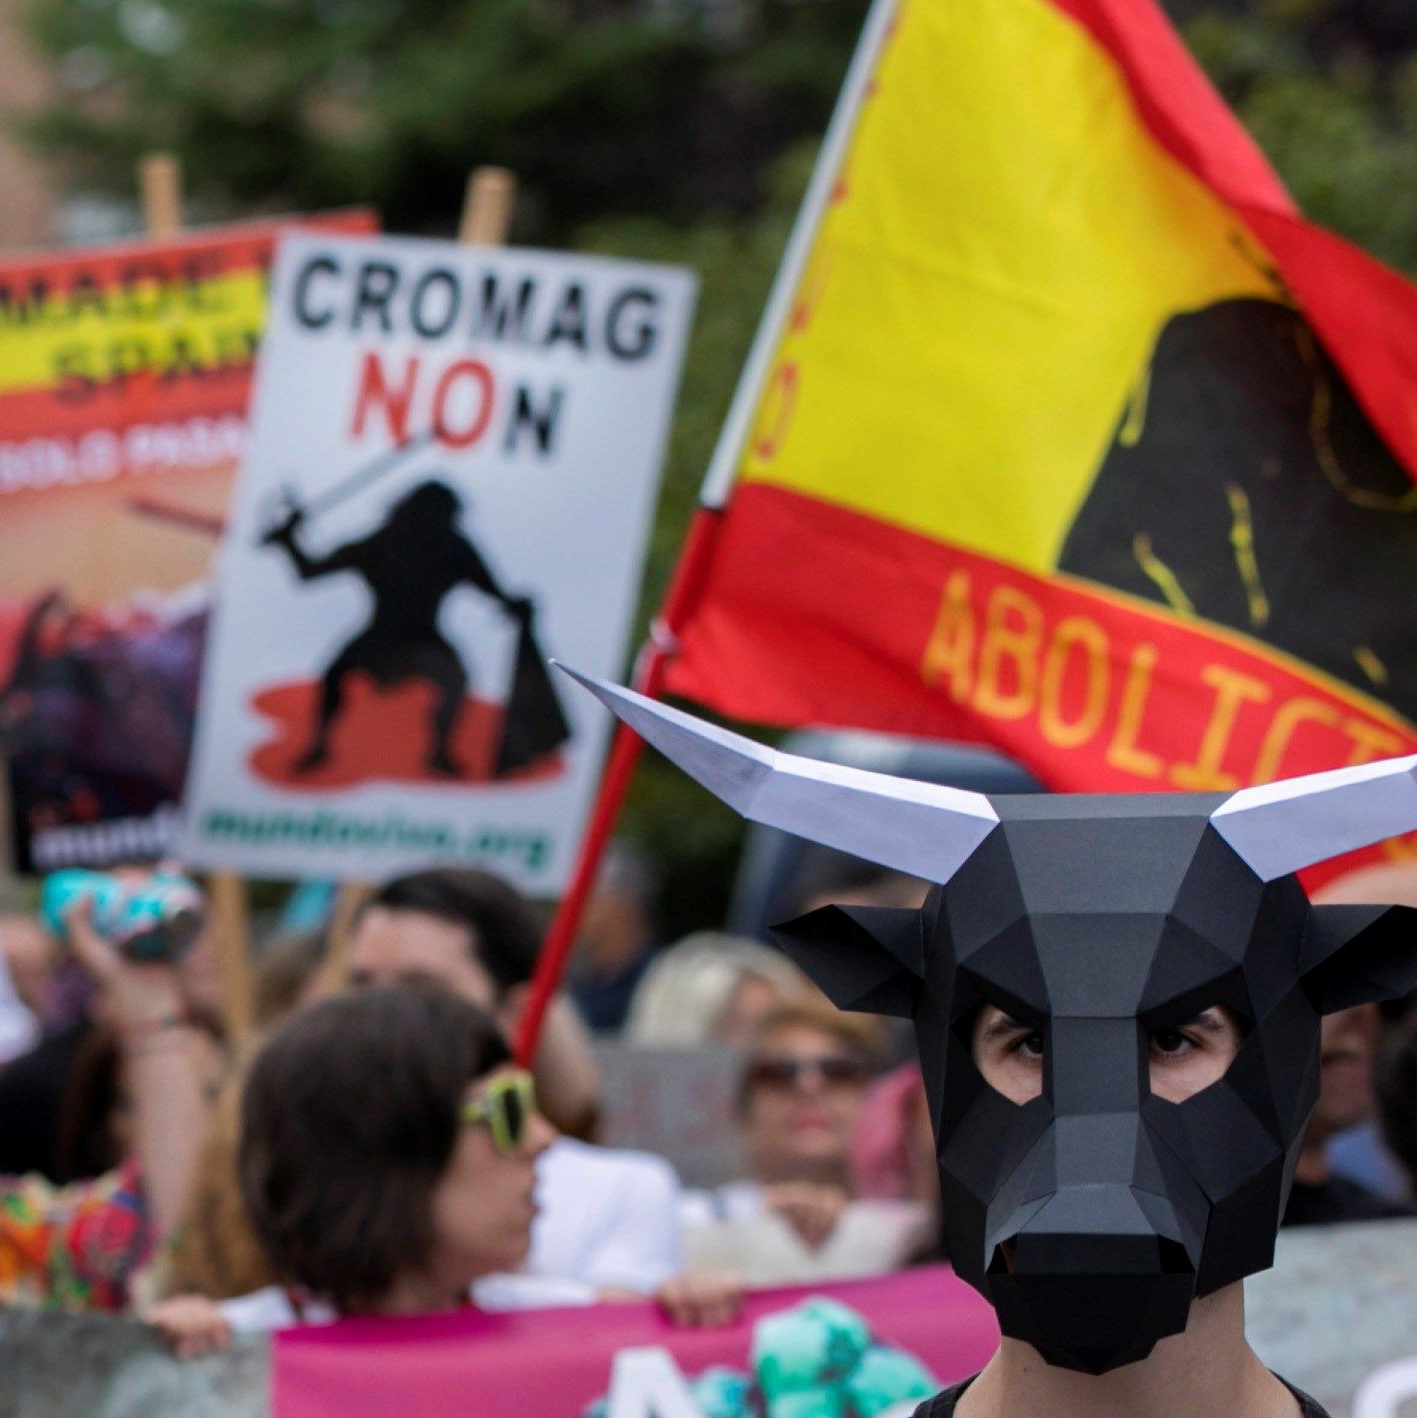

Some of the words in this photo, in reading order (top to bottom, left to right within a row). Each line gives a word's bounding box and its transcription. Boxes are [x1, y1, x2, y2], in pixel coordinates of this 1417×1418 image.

[290, 256, 660, 361] CROMAG
[350, 350, 566, 458] NON
[30, 802, 184, 870] mund
[204, 806, 551, 871] mundovivo.org
